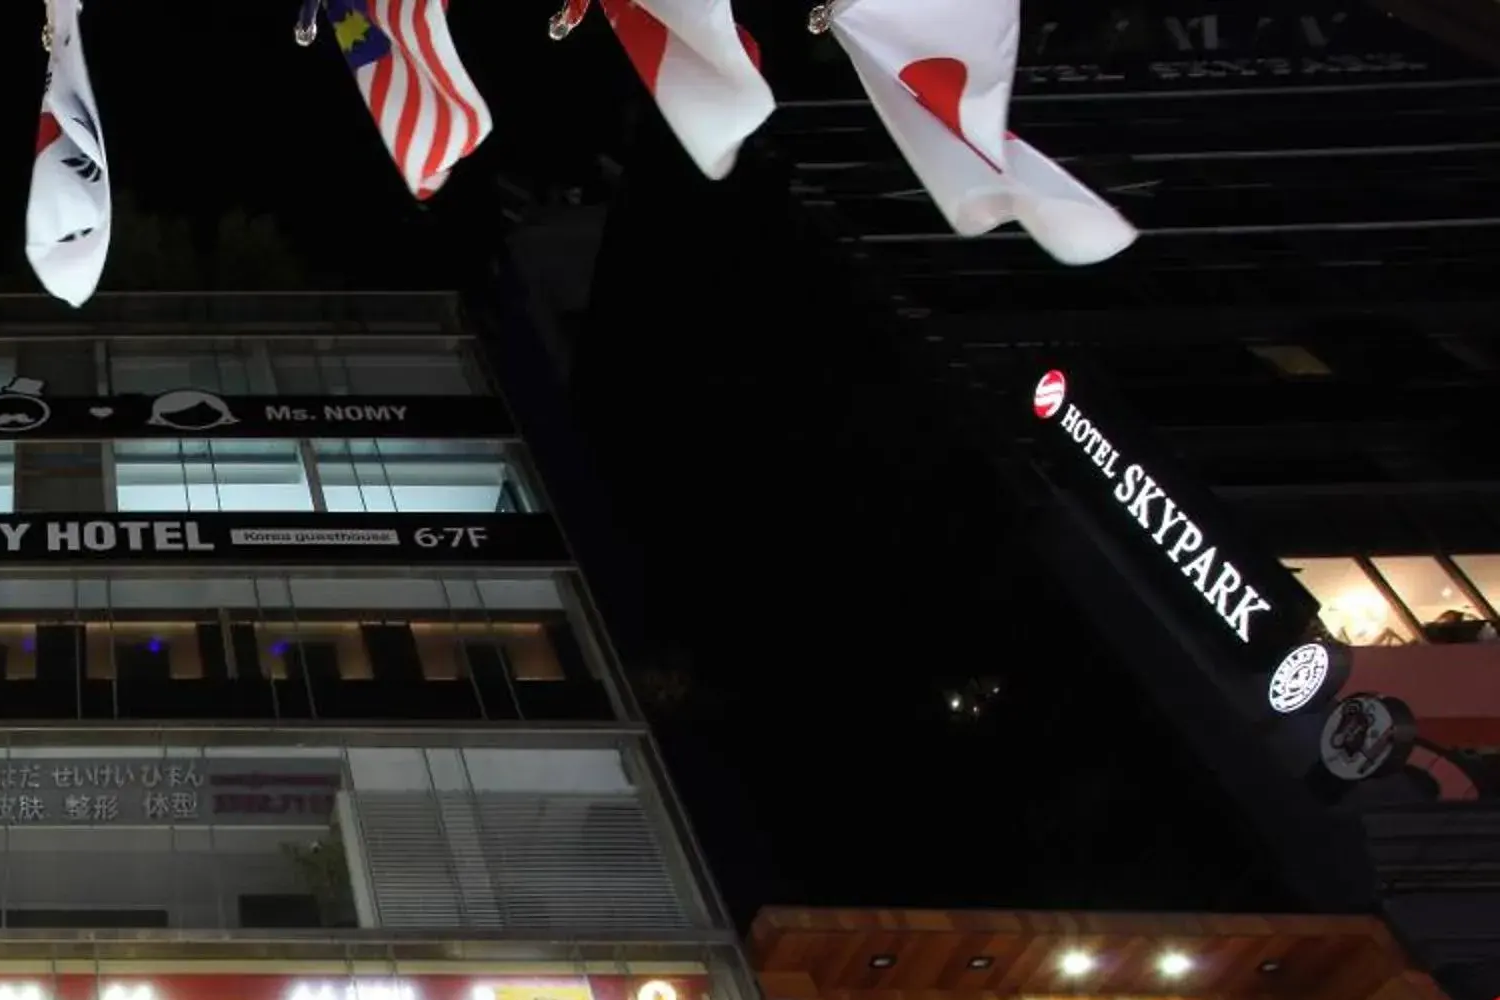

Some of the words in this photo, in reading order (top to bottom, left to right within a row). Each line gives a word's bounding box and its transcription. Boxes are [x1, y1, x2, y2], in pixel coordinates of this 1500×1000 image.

[265, 405, 315, 421] Ms.
[324, 405, 408, 421] NOMY
[46, 520, 215, 552] HOTEL
[1060, 403, 1121, 480] HOTEL
[1113, 463, 1272, 644] SKYPARK
